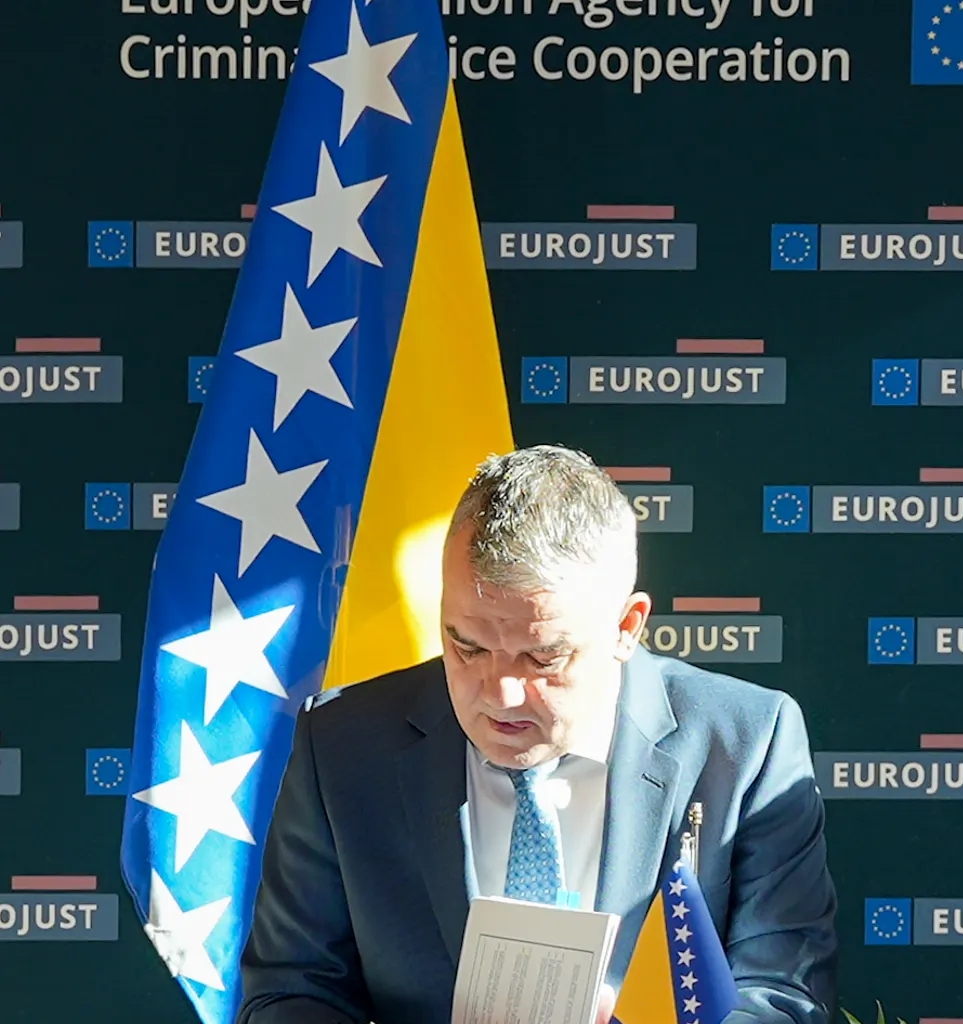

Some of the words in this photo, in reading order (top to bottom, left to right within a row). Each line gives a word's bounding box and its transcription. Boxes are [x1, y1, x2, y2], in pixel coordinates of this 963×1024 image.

[119, 34, 299, 80] Crimin
[532, 36, 850, 94] Cooperation
[500, 233, 675, 265] EUROJUST
[589, 367, 764, 399] EUROJUST
